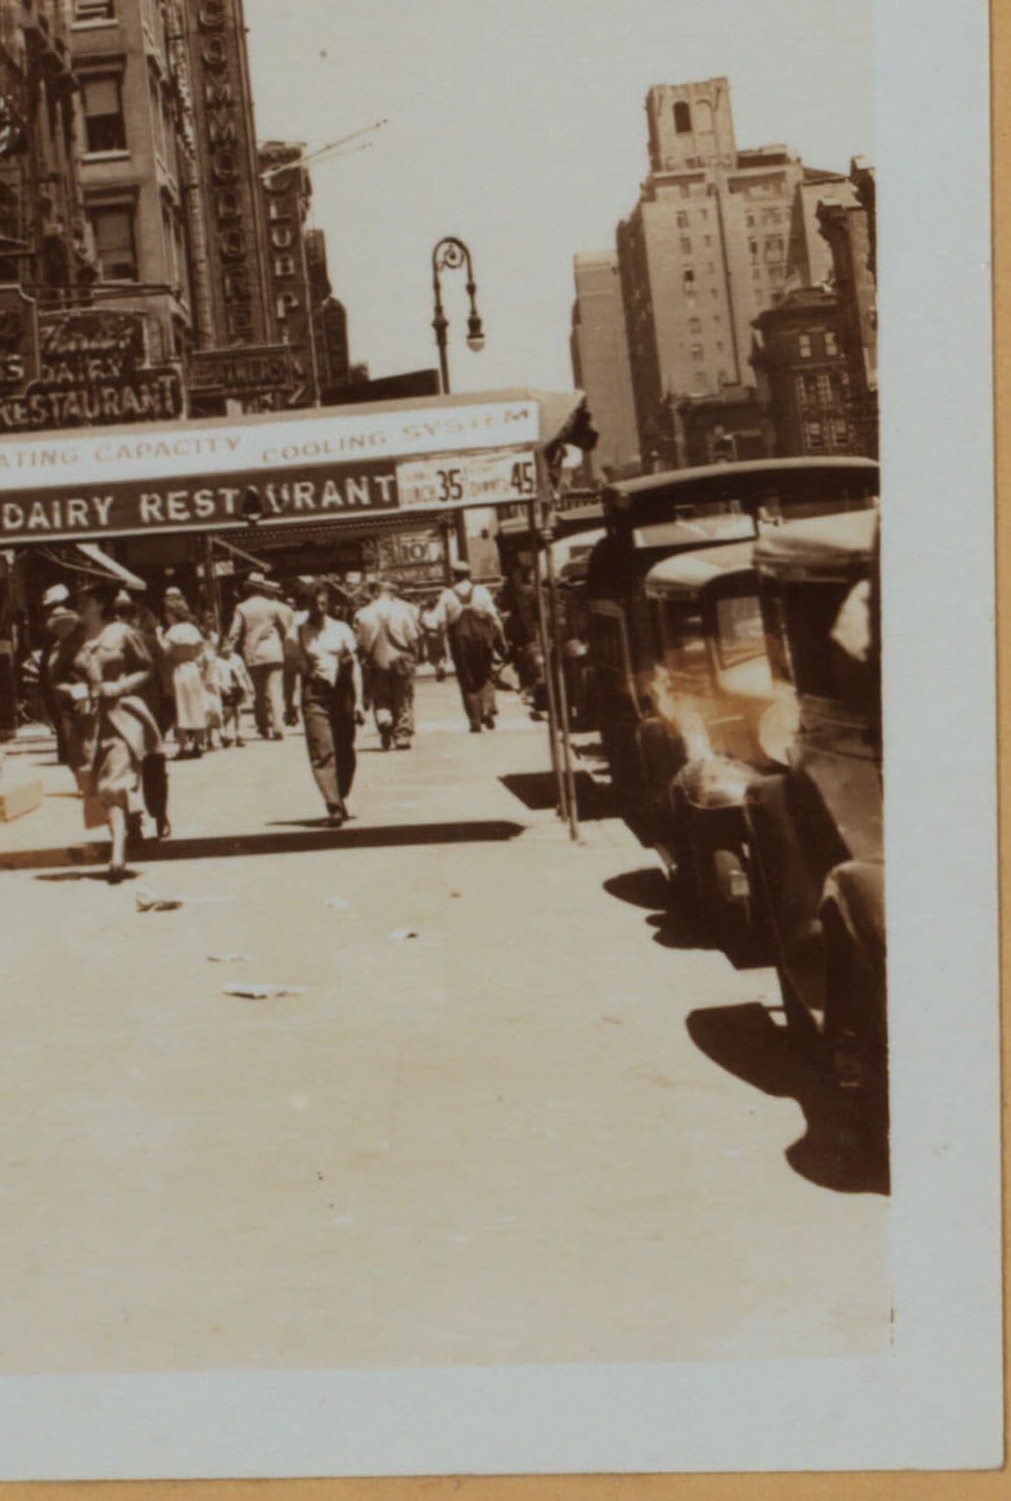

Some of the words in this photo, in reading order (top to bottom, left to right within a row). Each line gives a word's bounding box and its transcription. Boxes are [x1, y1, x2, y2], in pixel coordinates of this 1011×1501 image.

[94, 434, 244, 464] CAPACITY
[261, 430, 388, 464] COOLING
[401, 407, 531, 445] SYSTEM
[435, 467, 463, 502] 35
[510, 461, 534, 495] 45
[0, 497, 116, 532] DAIRY
[139, 473, 396, 523] RESTURANT
